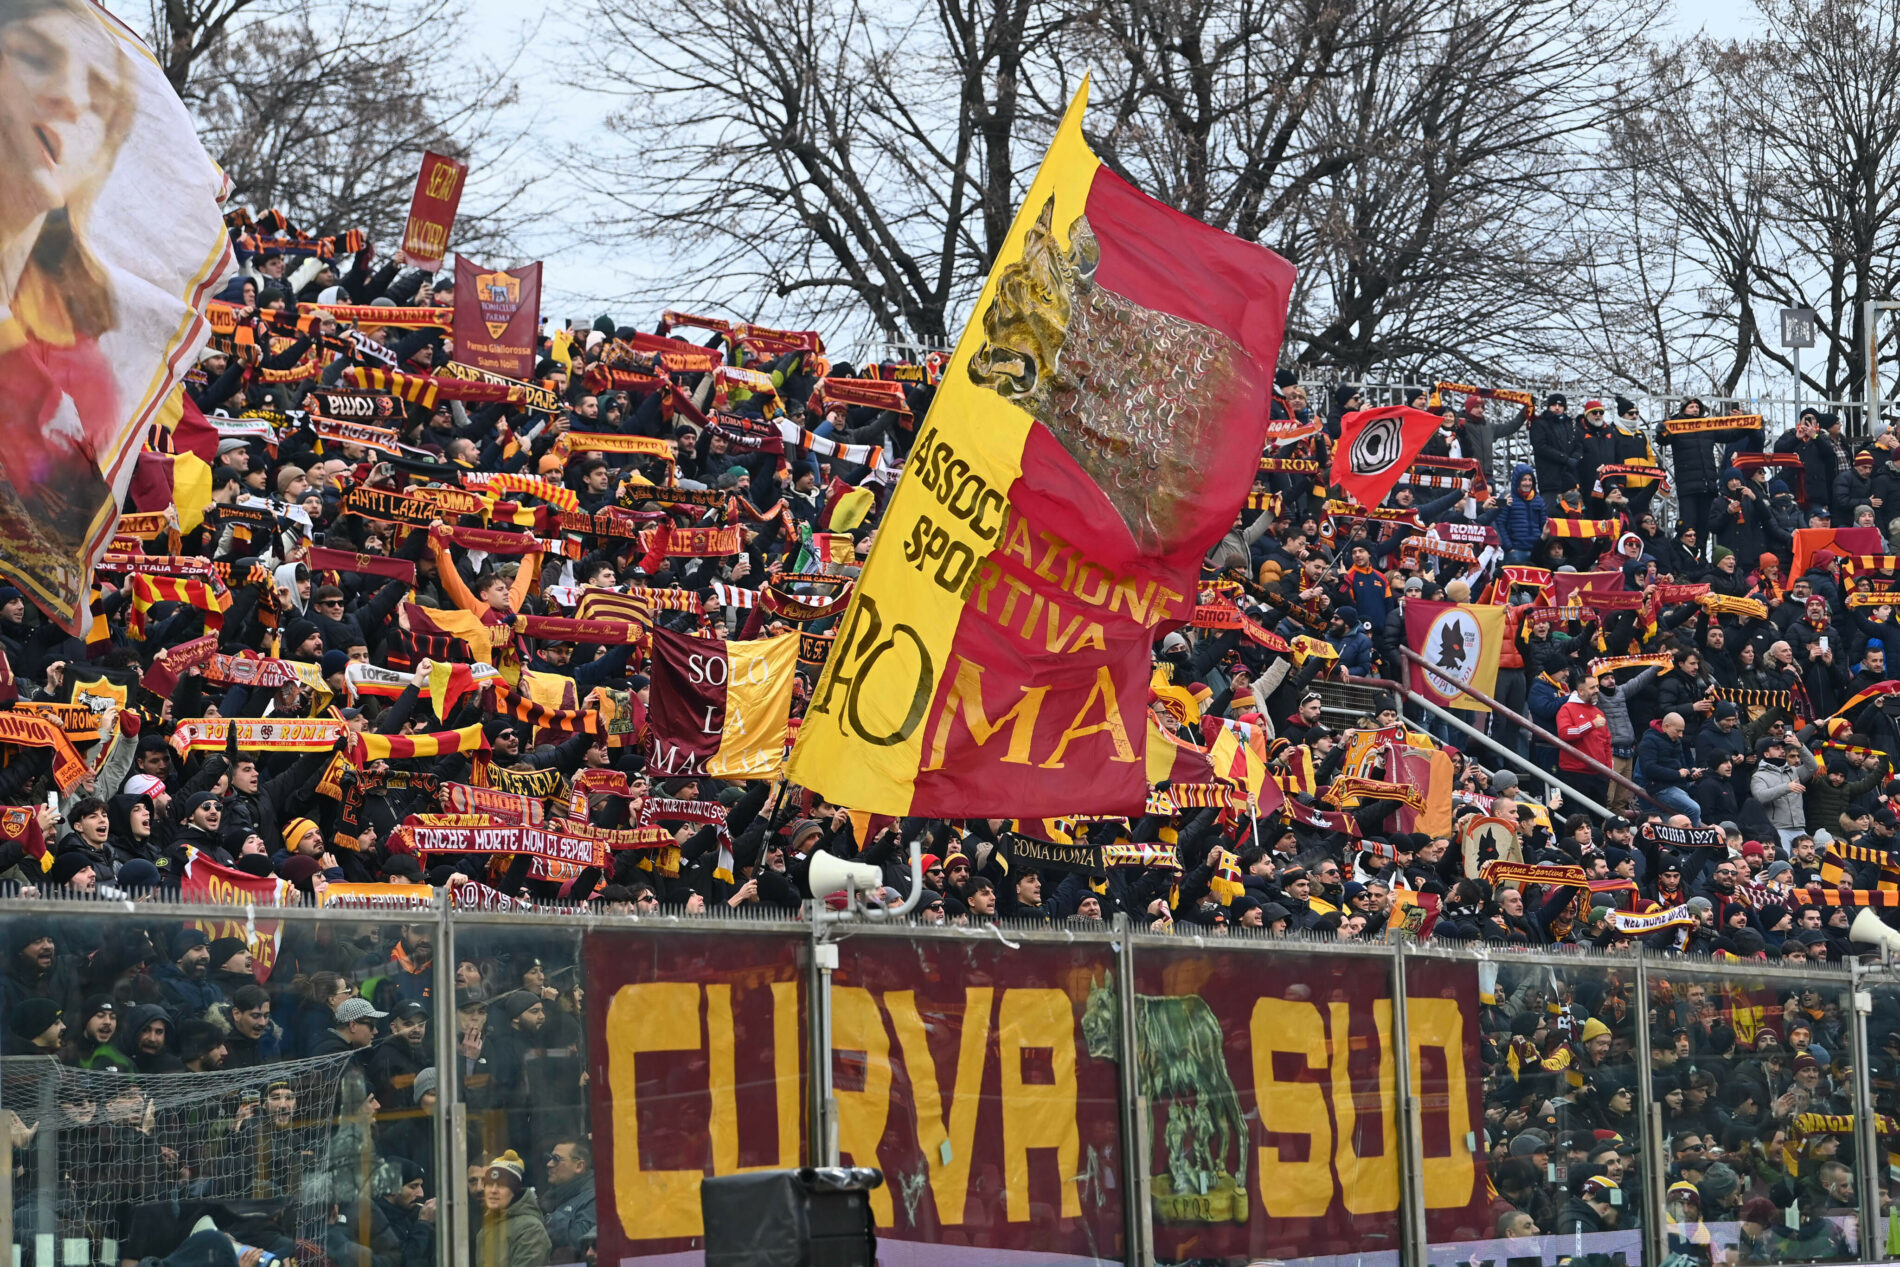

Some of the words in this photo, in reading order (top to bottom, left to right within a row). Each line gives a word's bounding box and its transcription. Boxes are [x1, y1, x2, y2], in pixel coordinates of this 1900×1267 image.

[327, 396, 374, 416] roma
[526, 386, 558, 410] DAJE
[1268, 421, 1297, 433] ROMA
[635, 441, 671, 456] PARM
[1280, 458, 1320, 472] ROM
[350, 489, 385, 513] ANTI
[119, 517, 156, 533] OMA
[908, 427, 1184, 628] ASSOCIAZIONE
[1449, 523, 1487, 536] ROMA
[904, 514, 1108, 655] SPORTIVA
[484, 625, 511, 647] OMA
[361, 665, 400, 682] forza
[688, 653, 769, 686] SOLO
[813, 591, 1142, 771] ROMA
[71, 711, 97, 729] ROM
[702, 705, 747, 736] LA
[280, 725, 327, 741] ROMA
[475, 829, 519, 852] MORTE
[546, 834, 558, 856] CI
[560, 837, 593, 862] SEPARI
[1688, 829, 1715, 845] 1927
[1013, 839, 1049, 860] ROMA
[532, 855, 582, 879] ROM
[1528, 867, 1565, 881] Sportiva
[1624, 917, 1641, 930] NEL
[606, 981, 1082, 1241] CURVA
[1249, 996, 1476, 1218] SUD
